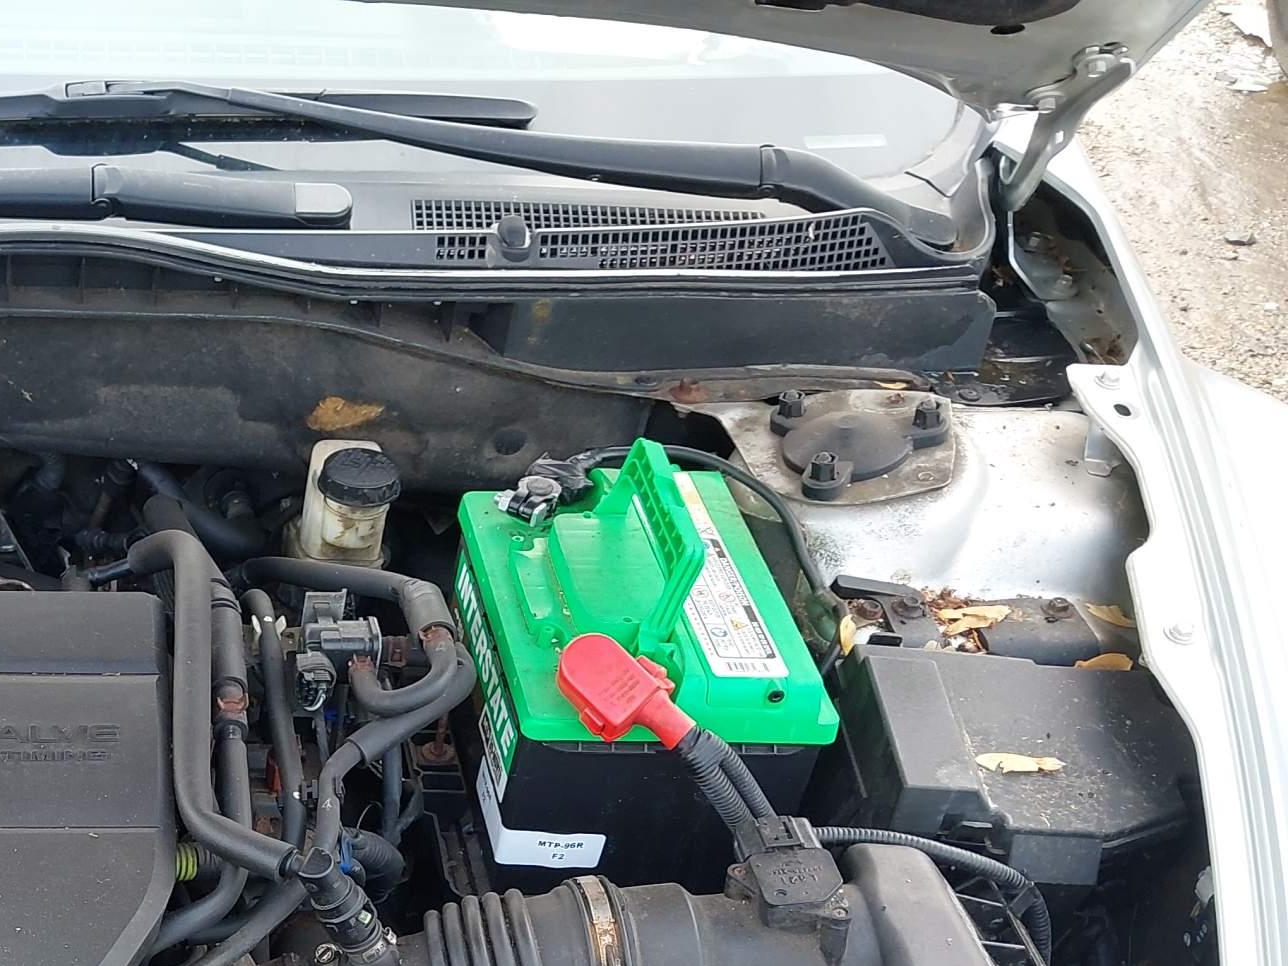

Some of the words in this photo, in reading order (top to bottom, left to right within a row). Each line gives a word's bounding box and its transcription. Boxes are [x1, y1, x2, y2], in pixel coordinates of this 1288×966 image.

[457, 563, 515, 757] INTERSTATE
[0, 750, 109, 762] TIMING
[537, 840, 584, 850] MTP-96R
